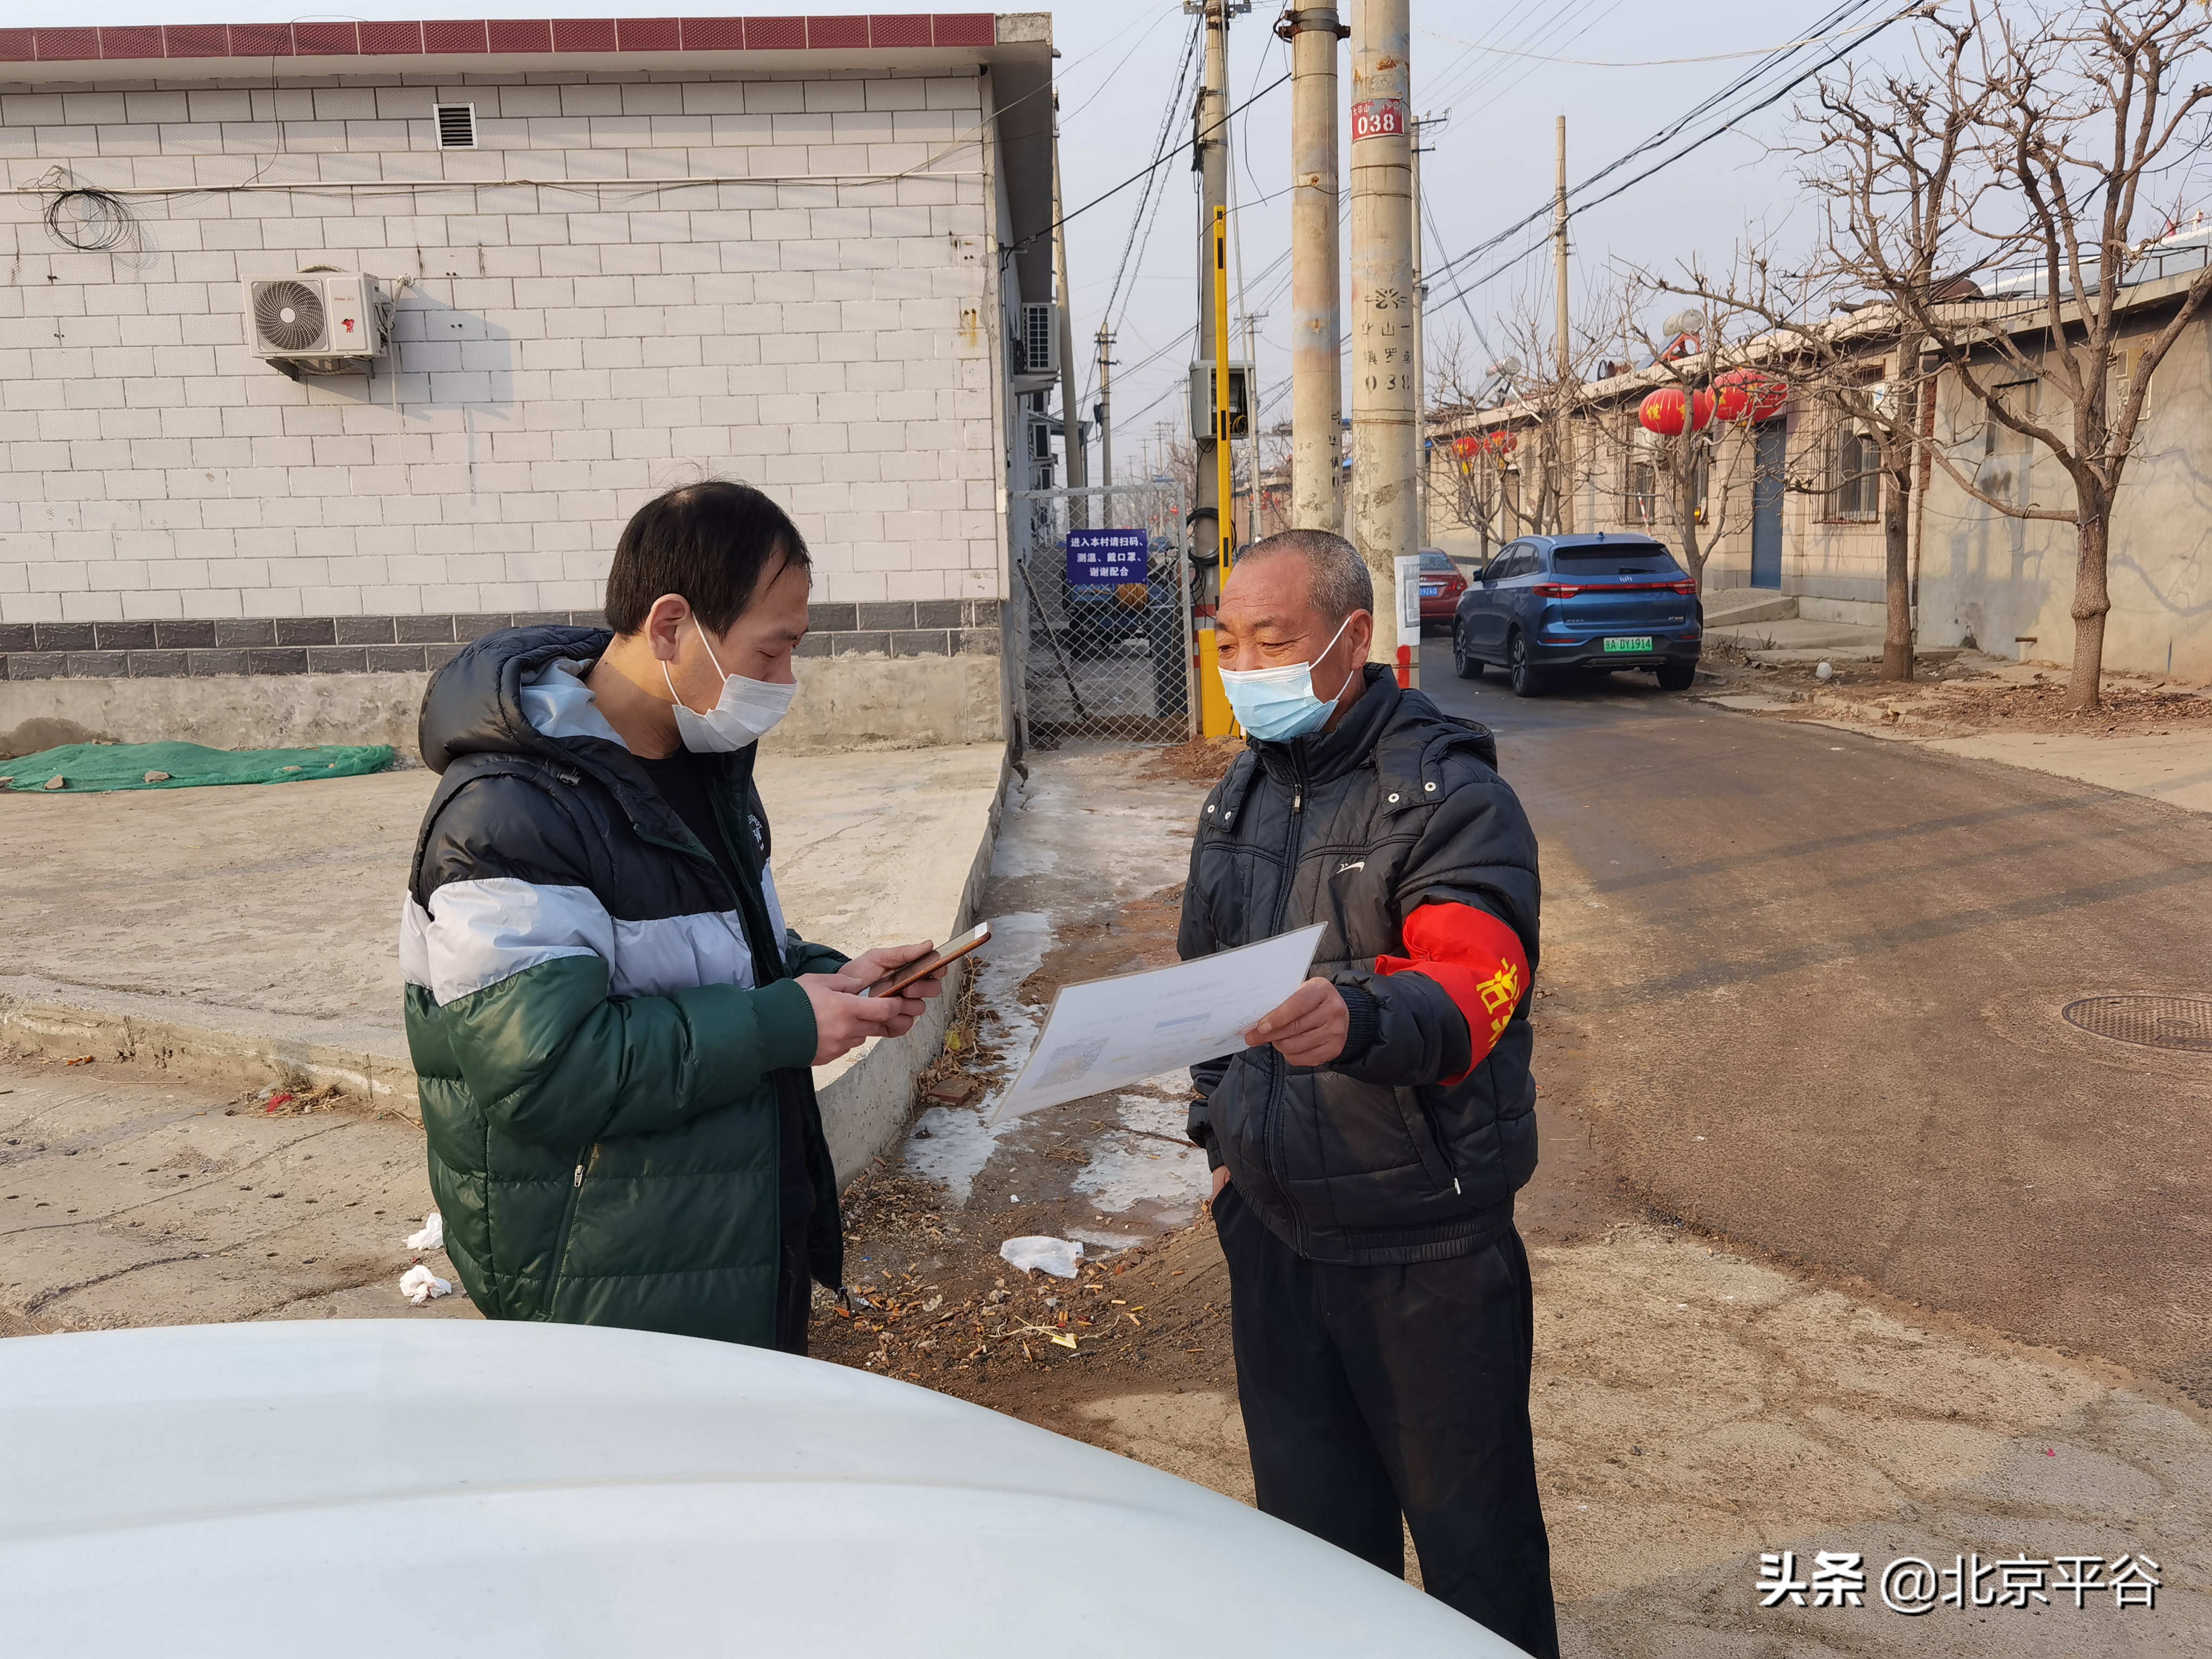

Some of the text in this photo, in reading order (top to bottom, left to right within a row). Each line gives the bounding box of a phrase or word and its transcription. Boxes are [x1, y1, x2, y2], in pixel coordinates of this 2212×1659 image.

[1358, 113, 1394, 134] 038
[1070, 536, 1143, 548] 进入本村请扫码、
[1076, 552, 1141, 563] 测温、戴口罩、
[1089, 566, 1129, 577] 谢谢配合
